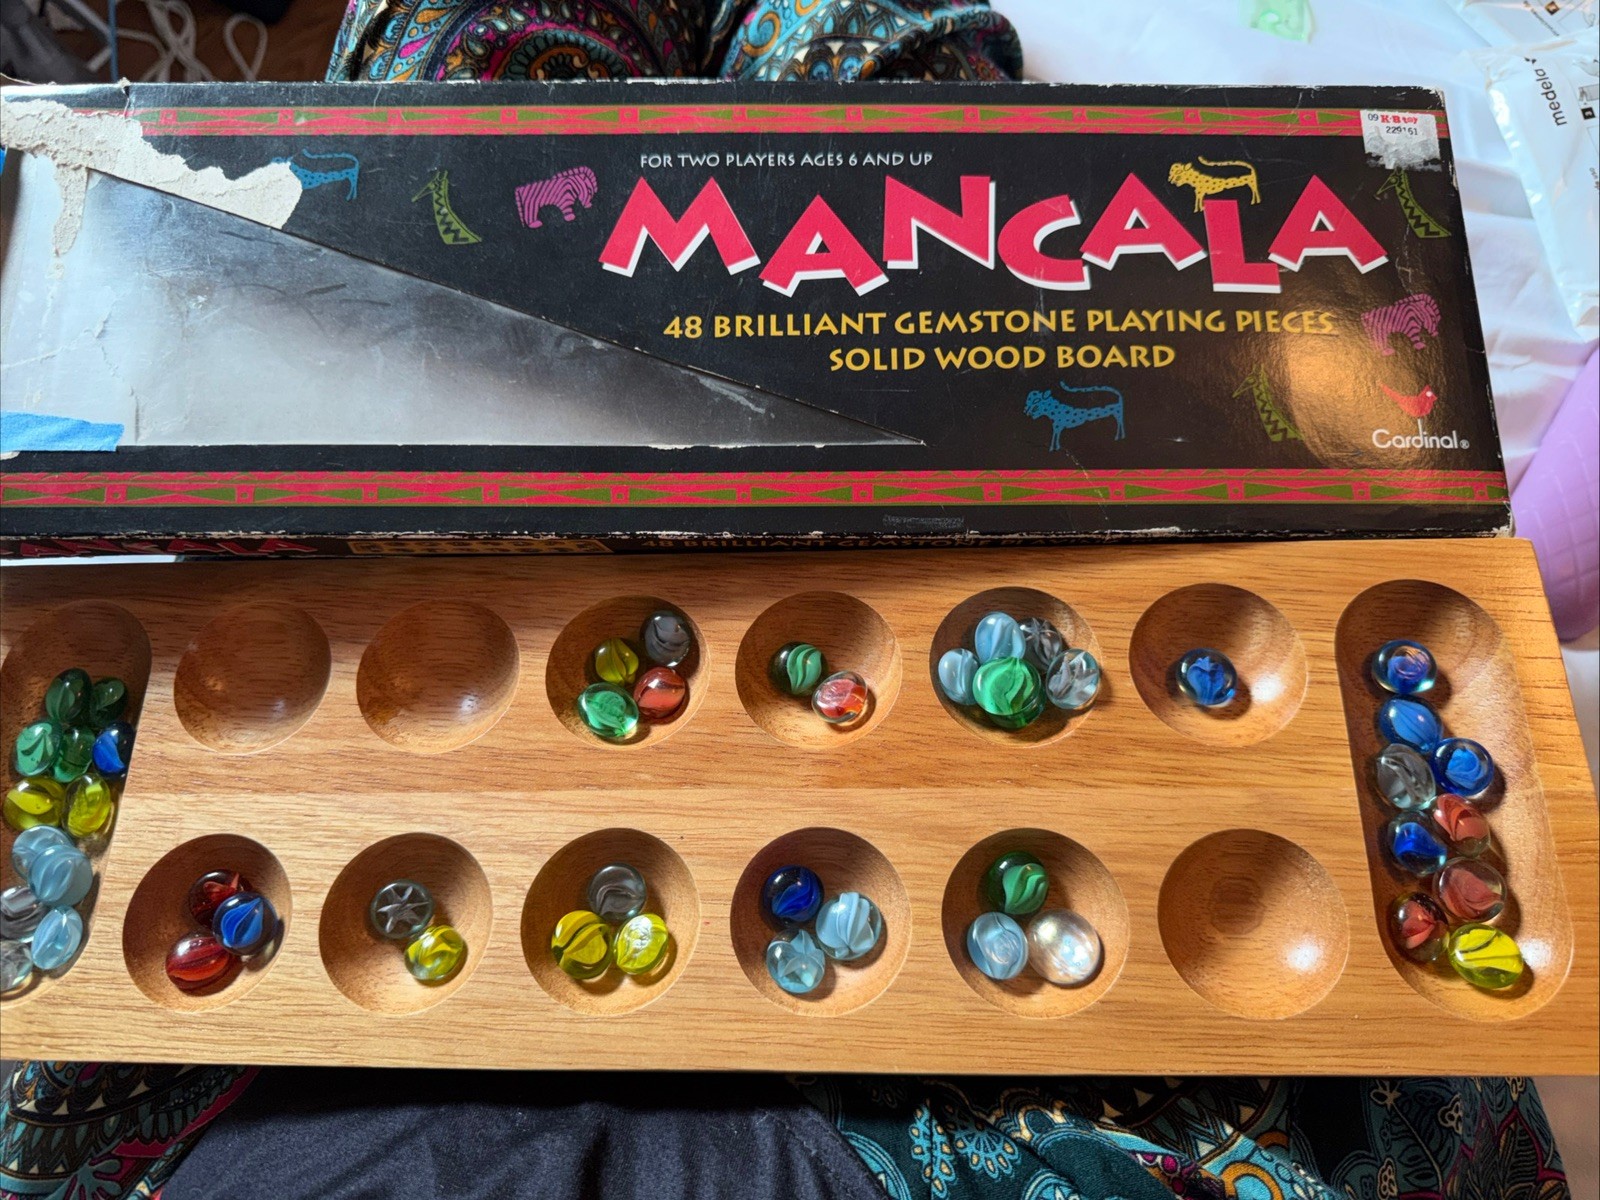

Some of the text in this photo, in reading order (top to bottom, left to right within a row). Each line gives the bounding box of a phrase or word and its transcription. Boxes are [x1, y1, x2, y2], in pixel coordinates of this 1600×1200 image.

[1534, 68, 1567, 126] medela
[1367, 113, 1379, 122] 09
[640, 152, 933, 168] FOR TWO PLAYERS AGES 6 AND UP
[598, 172, 1390, 297] MANCALA
[663, 309, 1335, 339] 48 BRILLIANT GEMSTONE PLAYING PIECES
[829, 344, 1176, 372] SOLID WOOD BOARD
[0, 538, 318, 557] ANCALA
[641, 540, 675, 548] 48
[683, 539, 832, 548] BRILLIANT
